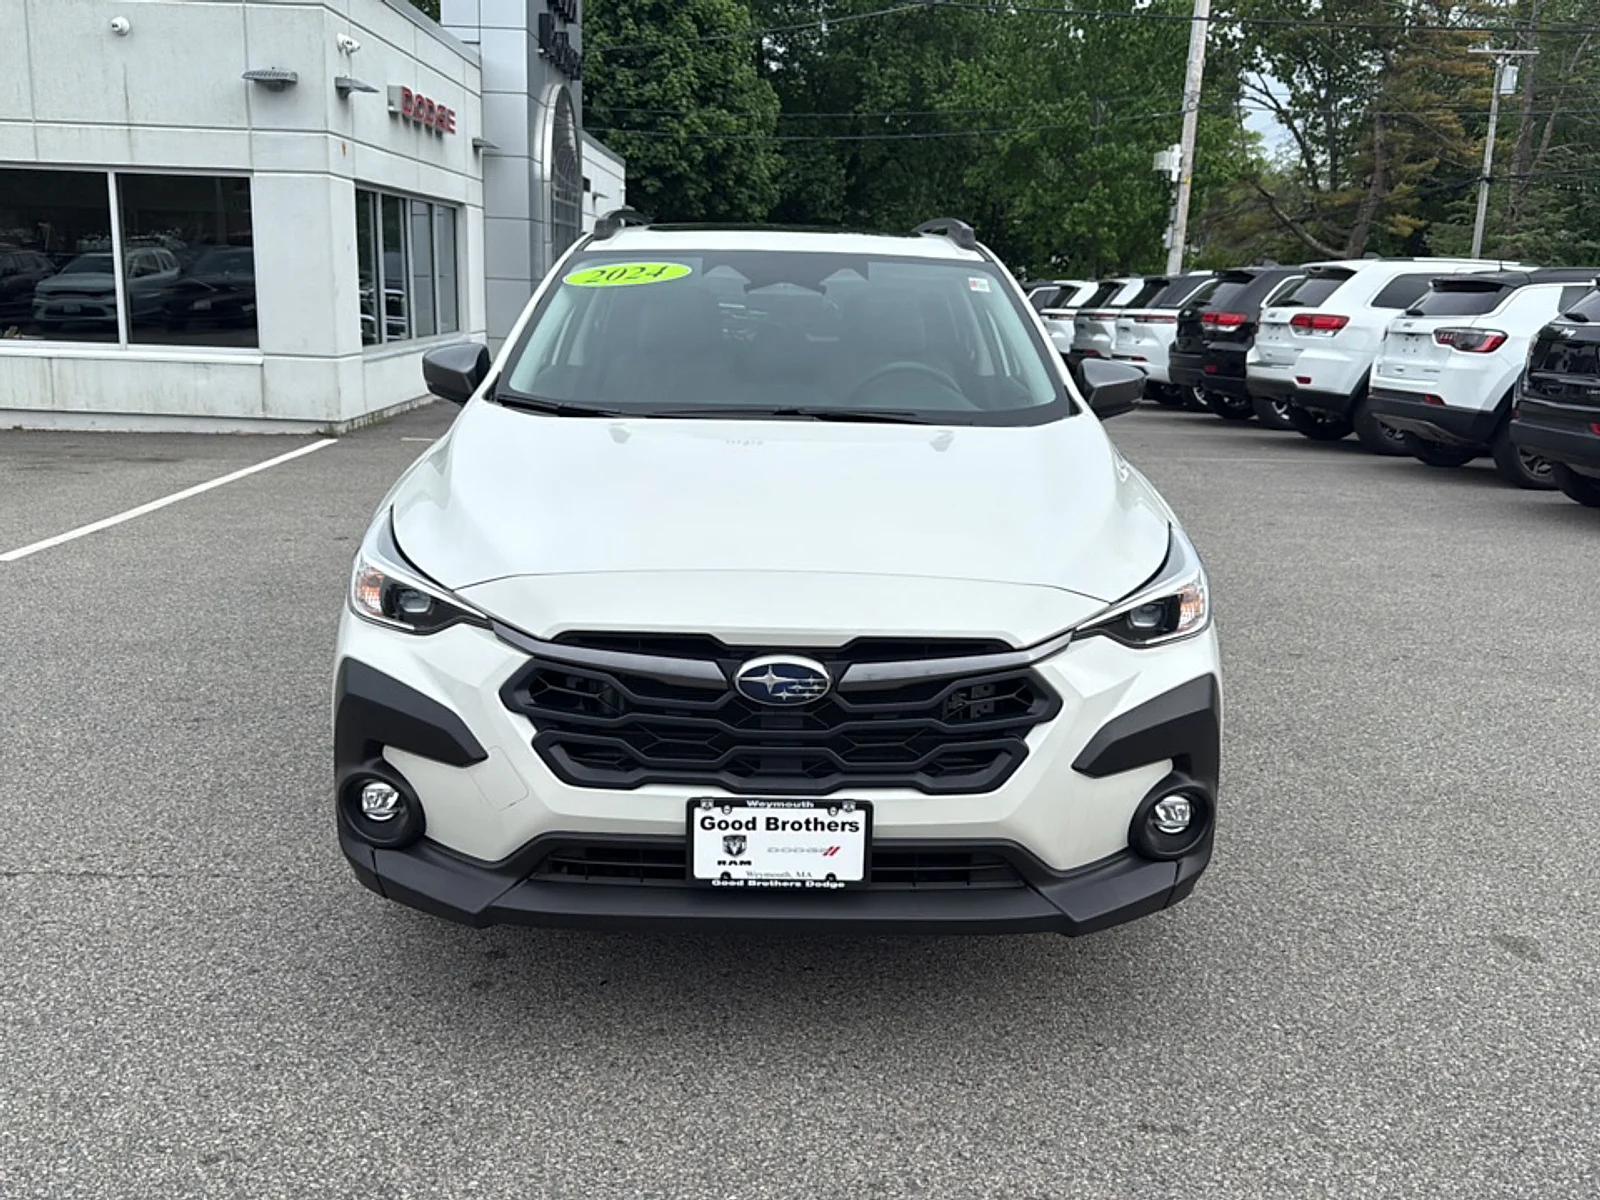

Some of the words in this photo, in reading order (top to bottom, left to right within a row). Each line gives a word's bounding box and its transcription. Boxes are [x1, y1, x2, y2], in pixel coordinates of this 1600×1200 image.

[400, 86, 456, 135] DODGE
[584, 265, 669, 284] 2024
[746, 799, 815, 809] Weymouth
[700, 816, 757, 832] Good
[765, 816, 860, 833] Brothers
[717, 859, 752, 867] RAM
[711, 879, 745, 888] Good
[747, 879, 802, 888] Brothers
[805, 880, 846, 890] Dodge
